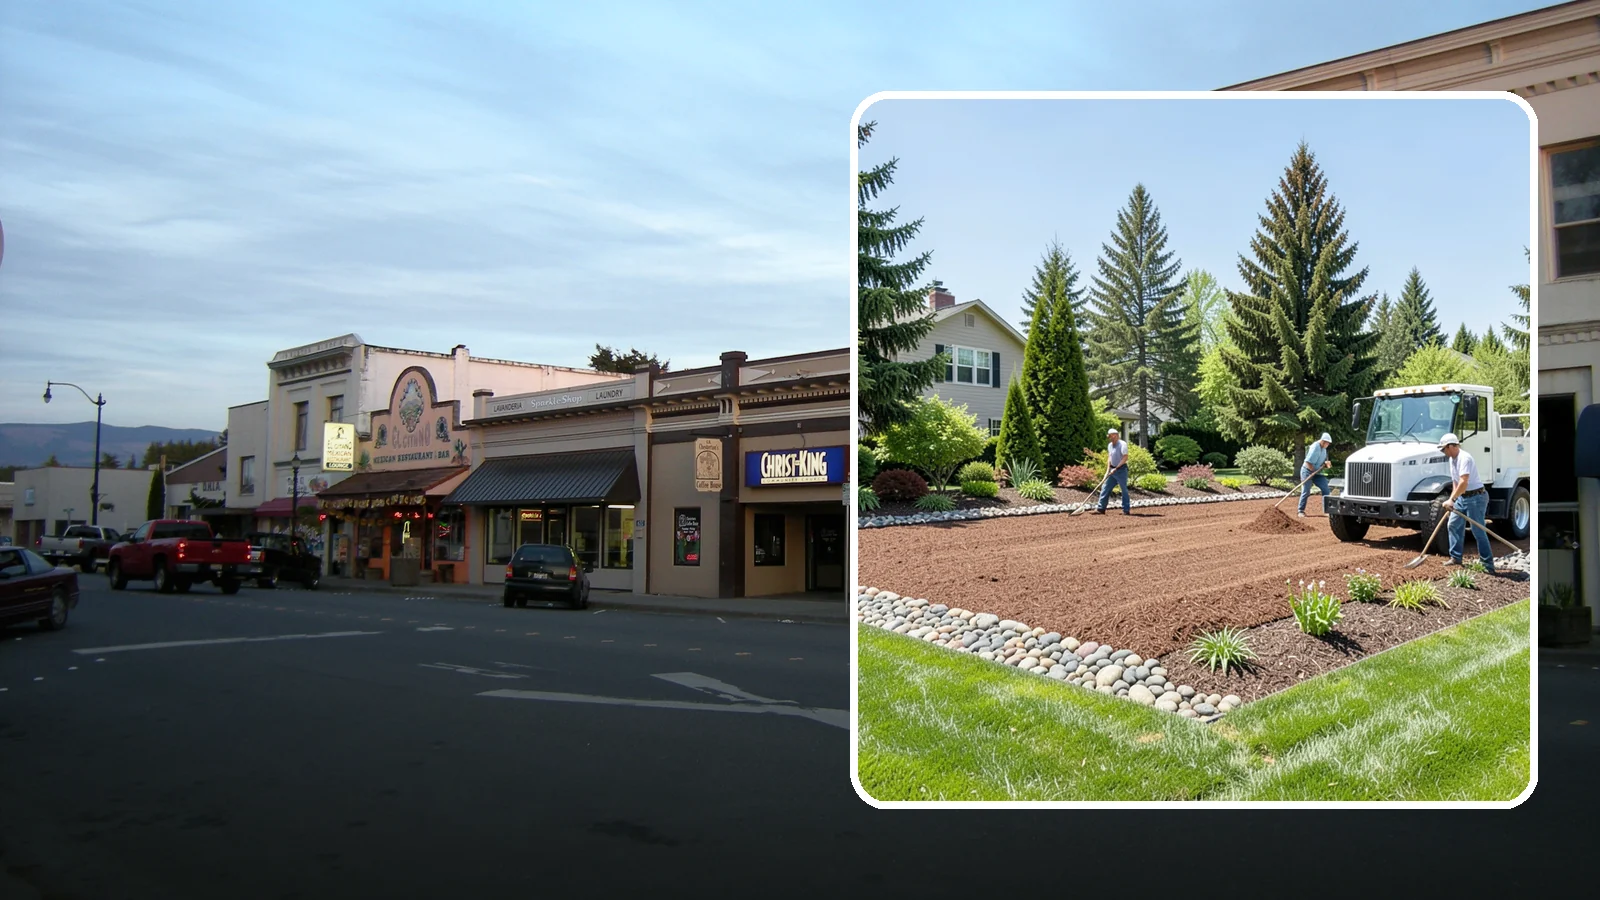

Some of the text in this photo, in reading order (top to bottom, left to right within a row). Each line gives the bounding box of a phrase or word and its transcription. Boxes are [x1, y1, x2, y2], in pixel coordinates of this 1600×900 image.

[595, 389, 623, 400] LAUNDRY
[493, 402, 522, 412] LAVANDERIA
[374, 454, 396, 464] MEXICAN
[397, 451, 433, 462] RESTAURANT
[438, 450, 450, 459] BAR
[761, 450, 827, 477] CHRIST KING
